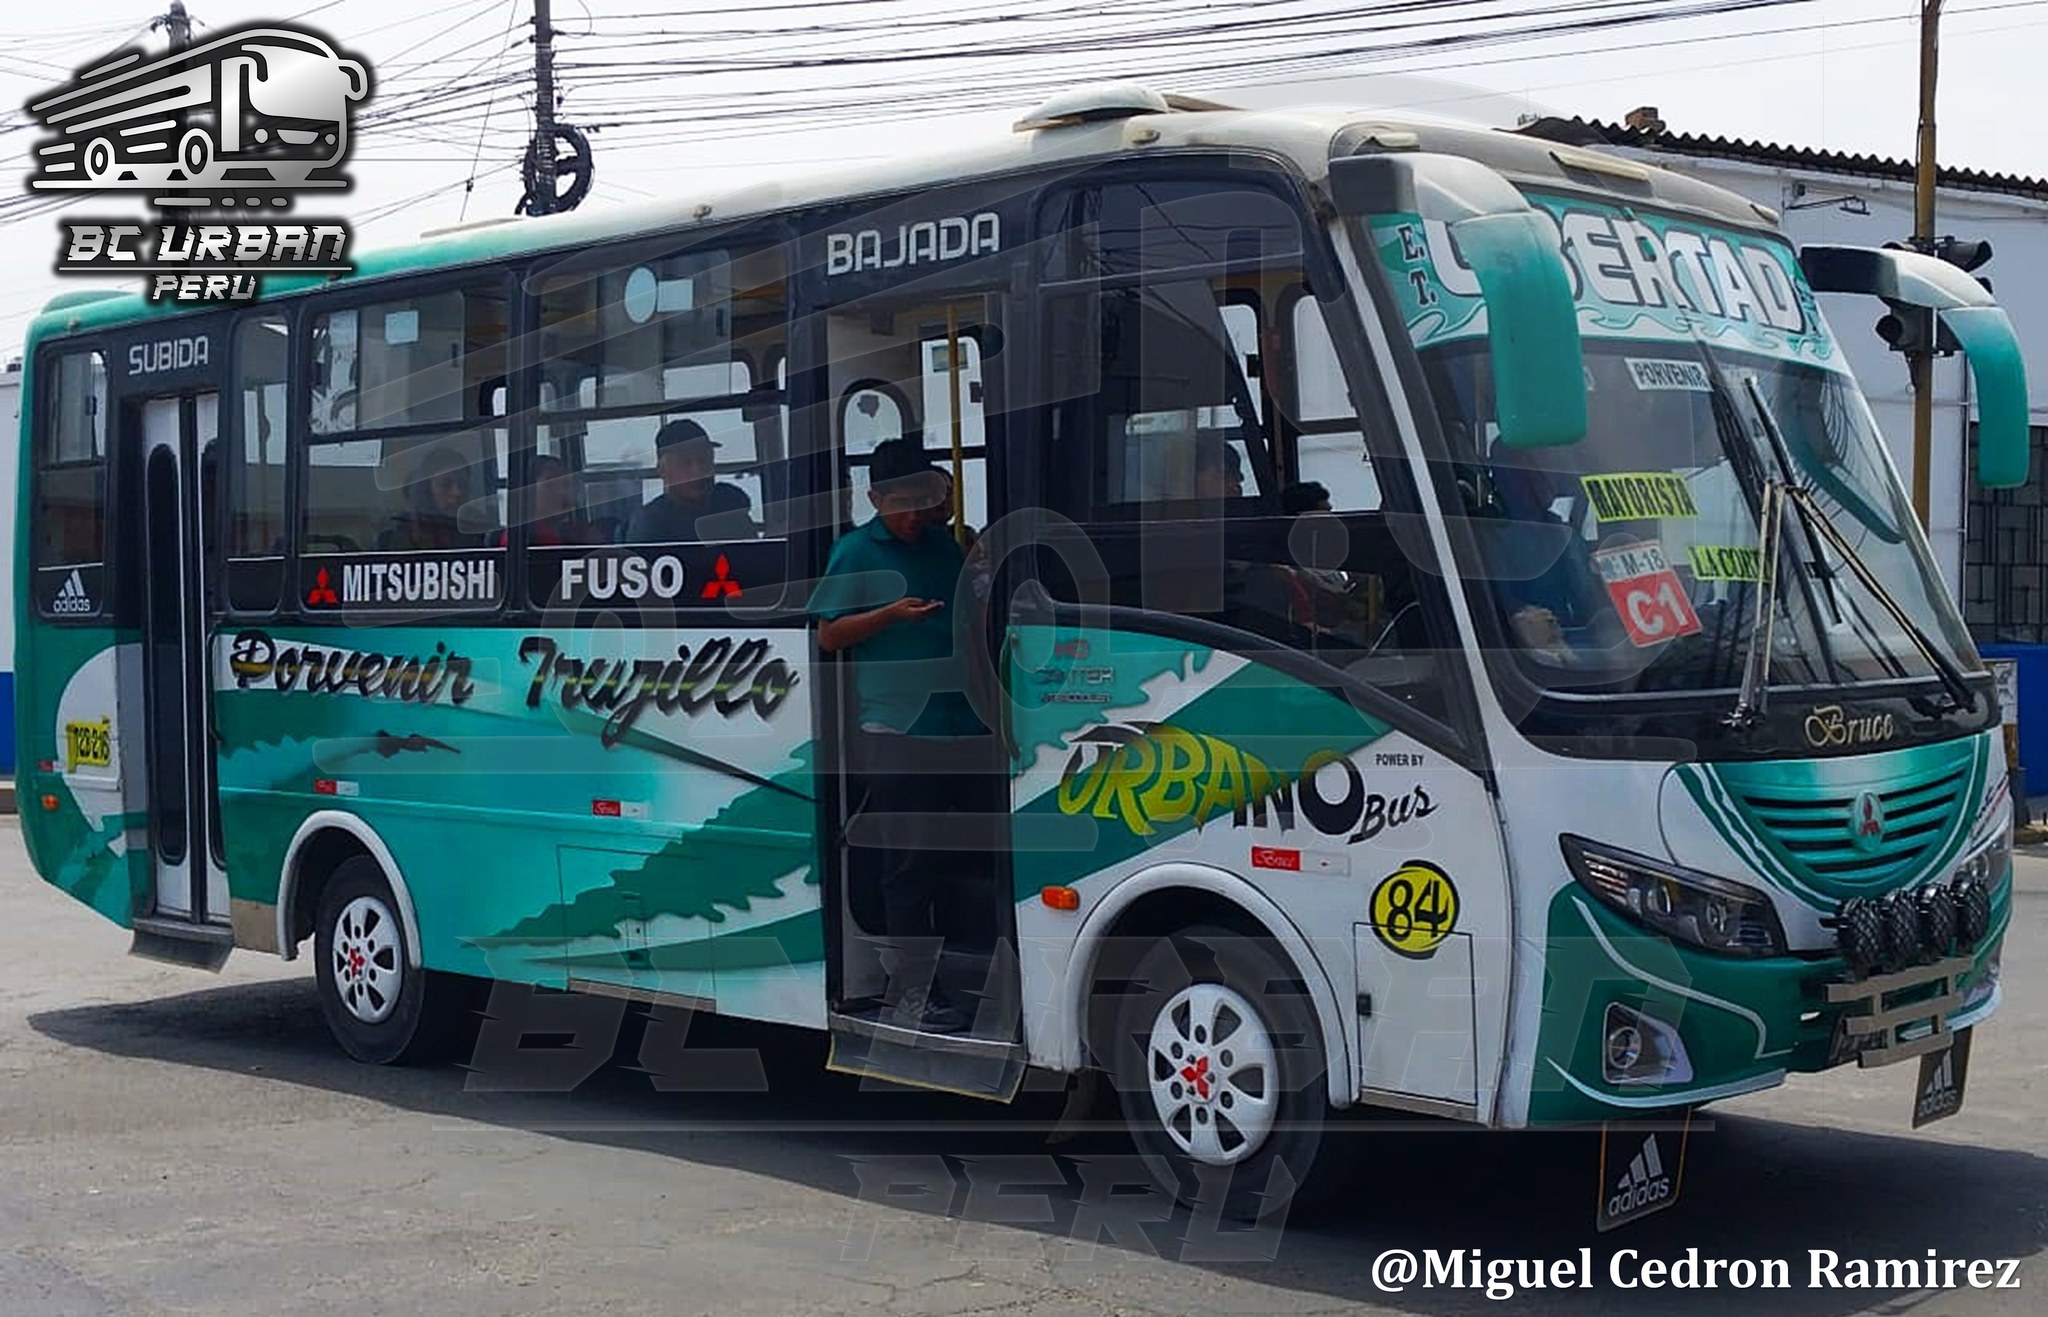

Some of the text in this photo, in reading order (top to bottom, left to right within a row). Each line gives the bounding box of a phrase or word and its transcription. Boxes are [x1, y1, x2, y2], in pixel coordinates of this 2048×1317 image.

[826, 212, 1000, 276] BAJADA
[128, 336, 209, 376] SUBIDA
[1632, 361, 1710, 388] PORVENIR
[1586, 478, 1698, 520] MAYORISTA
[342, 559, 496, 603] MITSUBISHI
[560, 555, 685, 600] FUSO
[53, 597, 91, 613] adidas
[1626, 581, 1688, 635] C1
[229, 629, 476, 706] Porvenir
[517, 635, 801, 750] Trujillo
[1058, 721, 1366, 837] URBANO
[1376, 753, 1425, 767] POWER BY
[1386, 877, 1449, 940] 84
[1608, 1174, 1671, 1217] adidas
